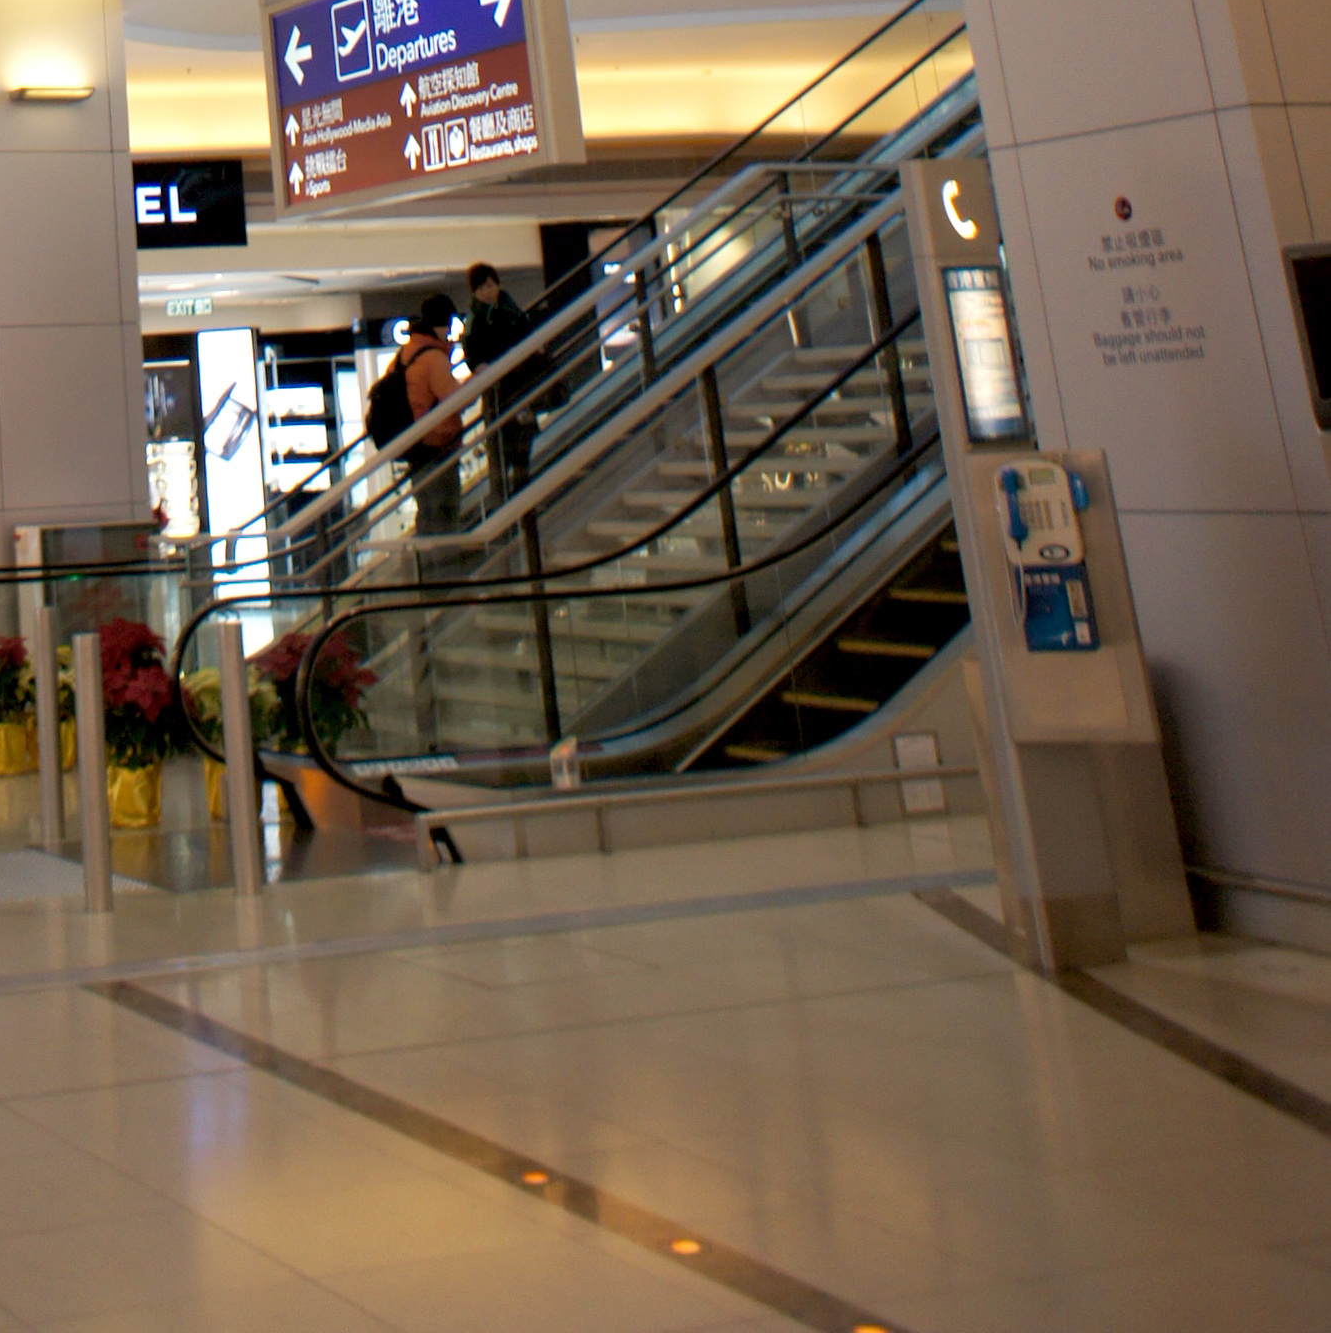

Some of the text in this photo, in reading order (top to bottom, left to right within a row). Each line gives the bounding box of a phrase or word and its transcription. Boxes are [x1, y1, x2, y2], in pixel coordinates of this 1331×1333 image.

[376, 29, 457, 74] Departures
[420, 82, 519, 118] Aviation Discovery Centre
[514, 134, 539, 153] shops
[1088, 247, 1184, 271] No smoking area
[1186, 324, 1205, 339] not
